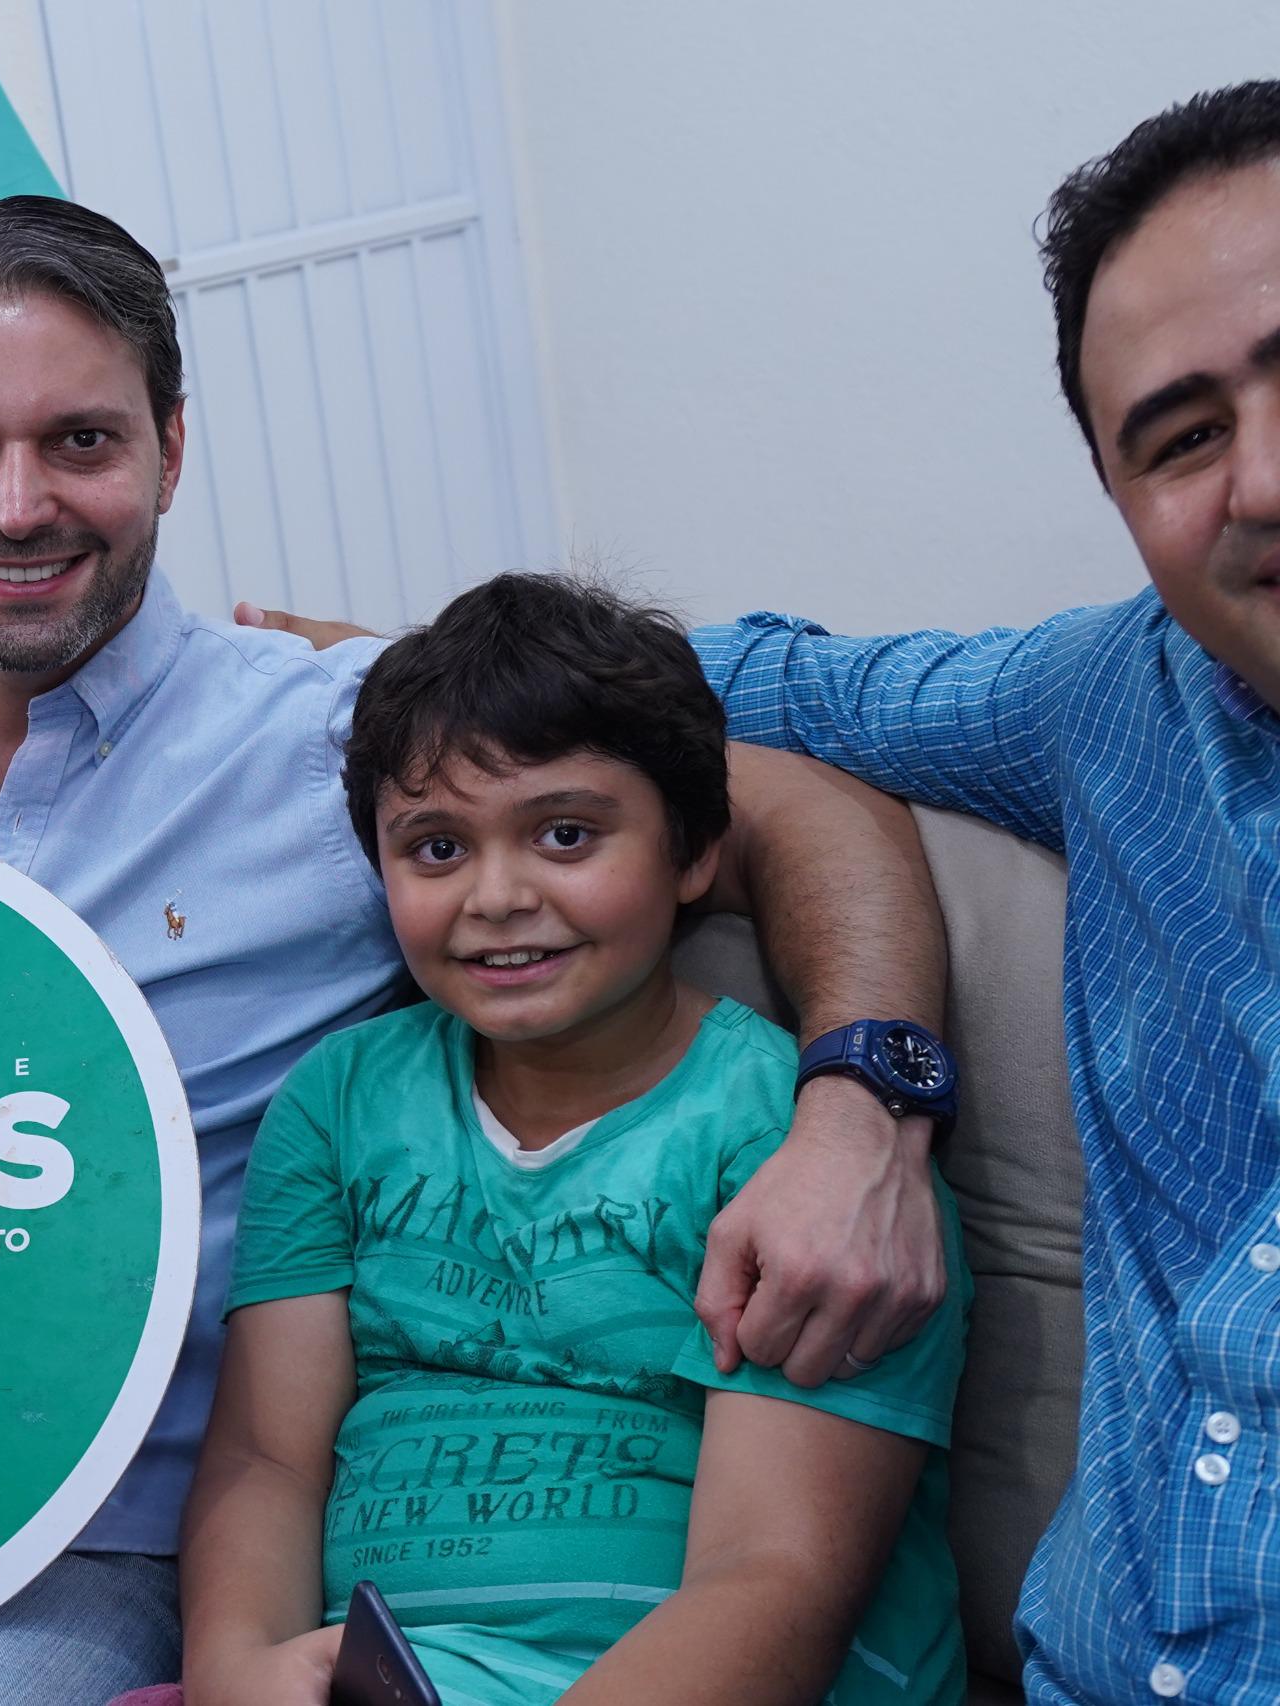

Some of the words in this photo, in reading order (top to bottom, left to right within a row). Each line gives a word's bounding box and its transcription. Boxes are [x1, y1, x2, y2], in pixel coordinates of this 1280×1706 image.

[420, 1401, 495, 1422] GREAT
[502, 1400, 567, 1418] KING
[596, 1408, 669, 1433] FROM
[351, 1494, 444, 1536] NEW
[467, 1483, 641, 1525] WORLD
[352, 1541, 415, 1568] SINCE
[426, 1537, 493, 1561] 1952
